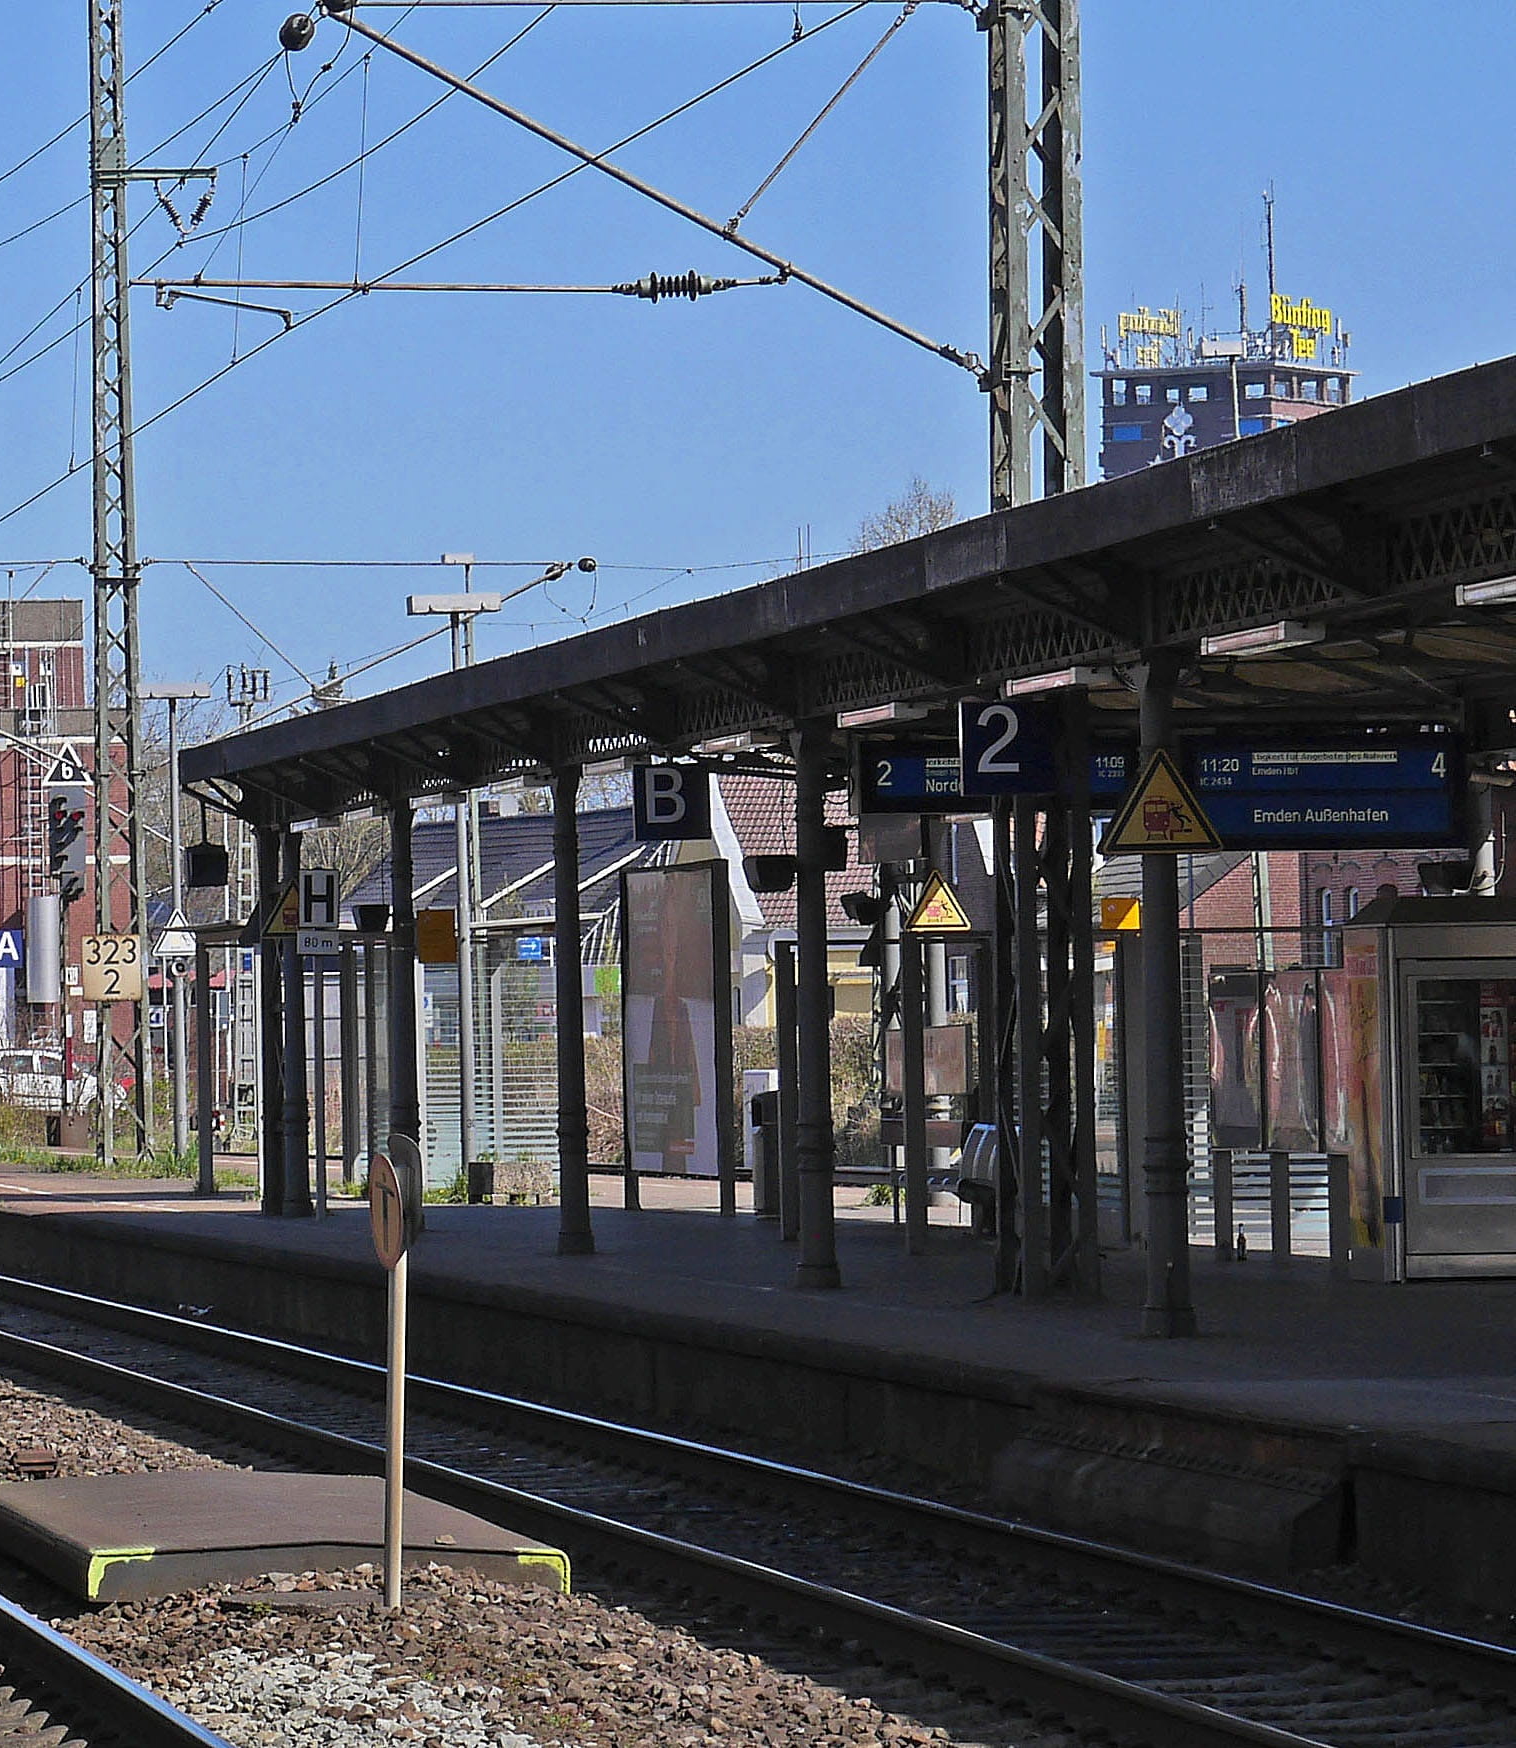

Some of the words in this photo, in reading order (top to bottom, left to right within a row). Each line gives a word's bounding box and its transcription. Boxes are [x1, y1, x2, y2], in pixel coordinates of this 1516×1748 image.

[1290, 328, 1316, 359] Tee
[977, 704, 1021, 773] 2
[876, 759, 894, 787] 2
[1095, 755, 1126, 769] 11:09
[1201, 758, 1240, 773] 11:20
[1430, 752, 1447, 778] 4
[645, 768, 686, 824] B
[1253, 808, 1301, 823] Emden
[1304, 807, 1389, 823] Außenhafen
[304, 874, 335, 923] H
[86, 938, 137, 966] 323
[322, 940, 333, 948] m
[103, 968, 121, 996] 2
